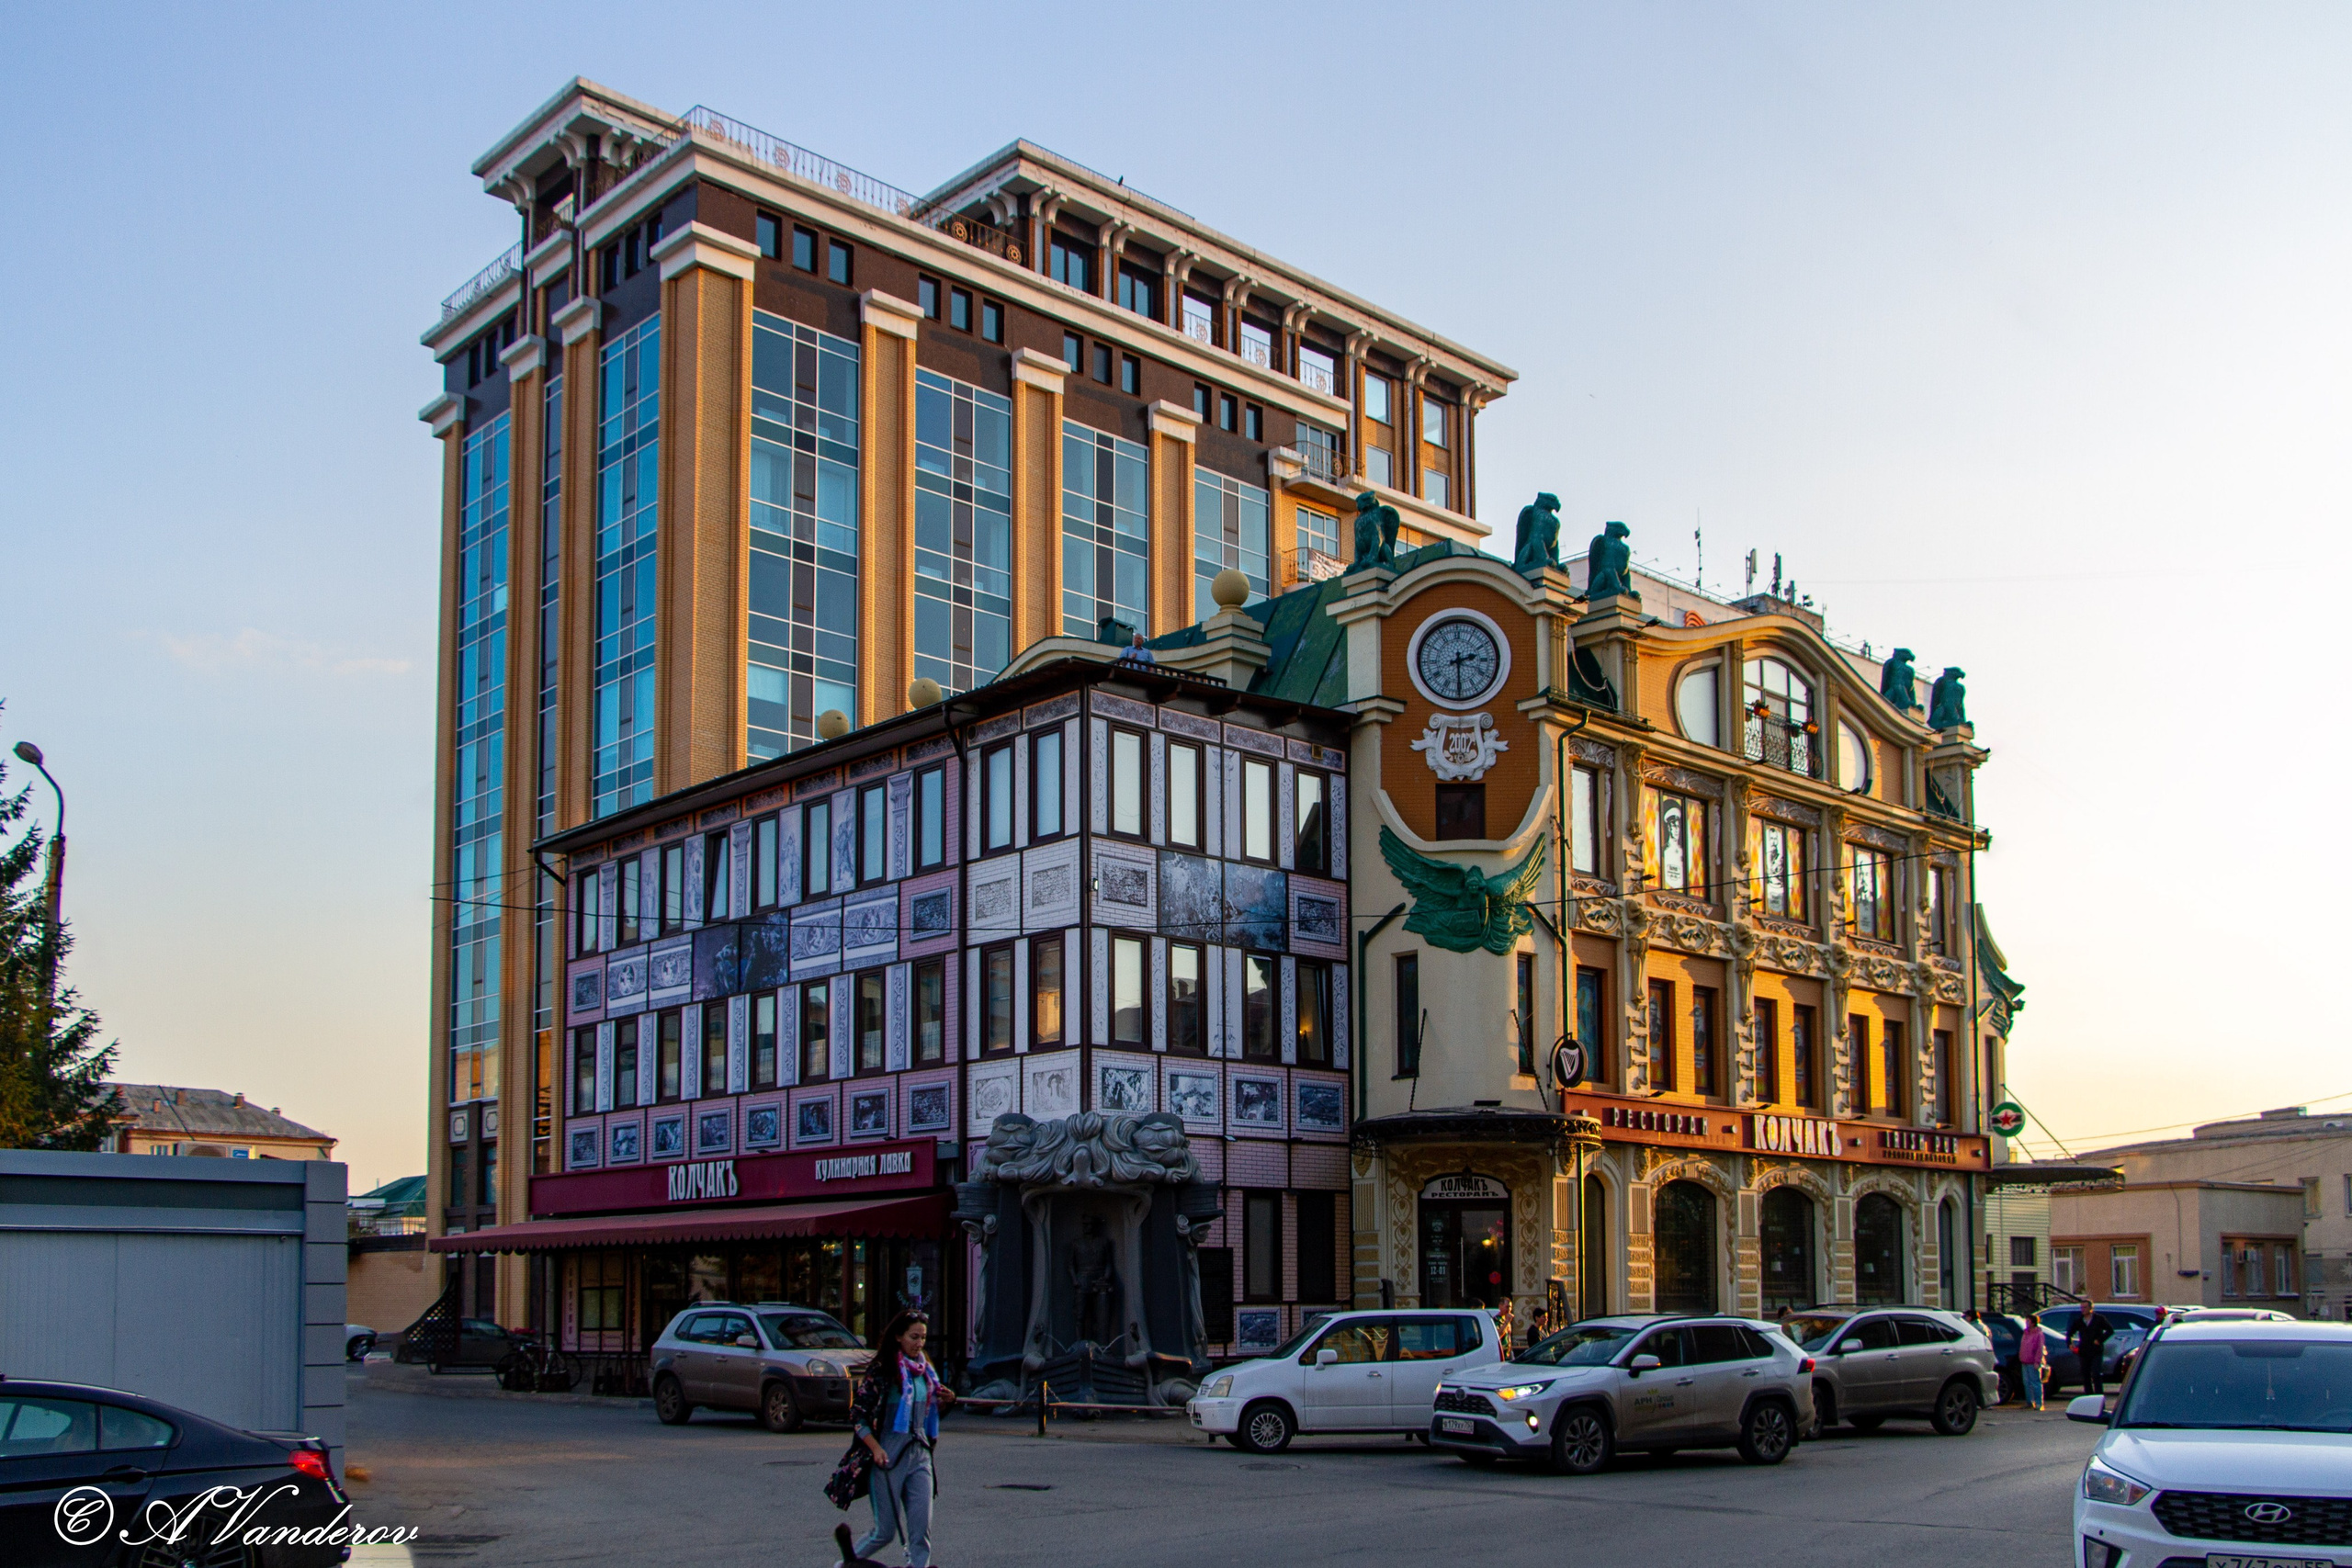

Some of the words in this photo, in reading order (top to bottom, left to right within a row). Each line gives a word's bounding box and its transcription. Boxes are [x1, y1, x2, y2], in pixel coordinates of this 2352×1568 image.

[1613, 1107, 1708, 1136] РЕСТОРАН
[1754, 1114, 1842, 1156] КОЛЧАКЪ
[668, 1160, 739, 1201] КОЛЧАКЪ
[1441, 1179, 1488, 1191] КОЛЧАКЪ
